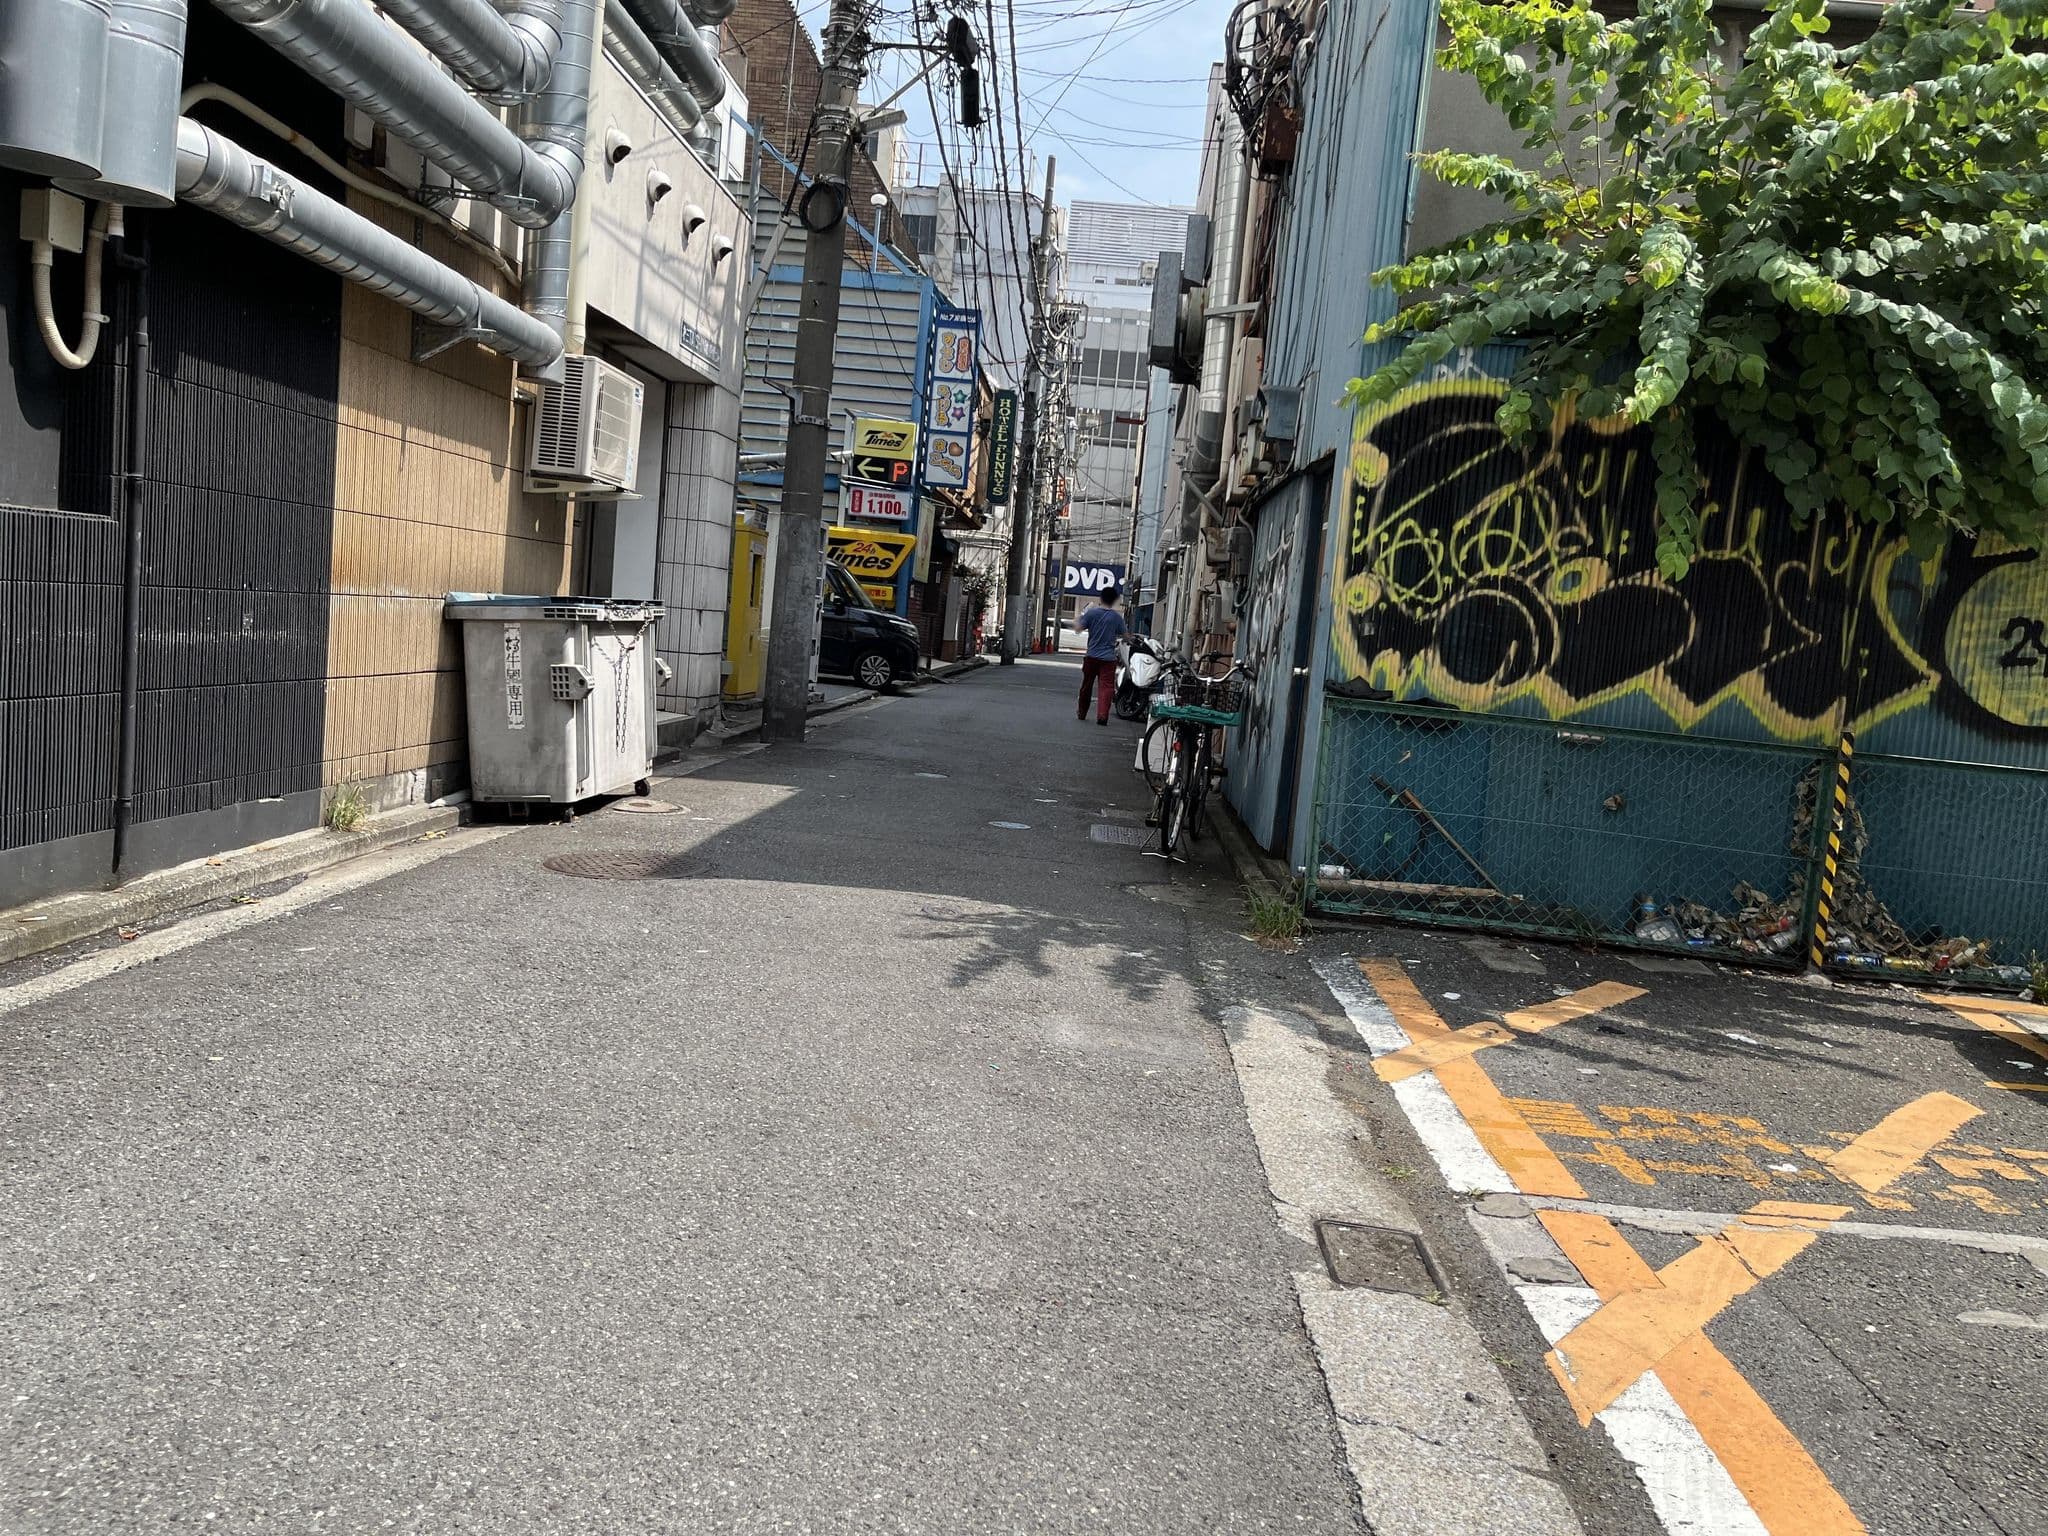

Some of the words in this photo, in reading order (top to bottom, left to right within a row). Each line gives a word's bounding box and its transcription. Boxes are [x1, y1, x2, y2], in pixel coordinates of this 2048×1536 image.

[997, 399, 1011, 442] HOTEL
[865, 434, 902, 448] Times
[827, 546, 894, 570] Times
[1064, 565, 1115, 591] DVD
